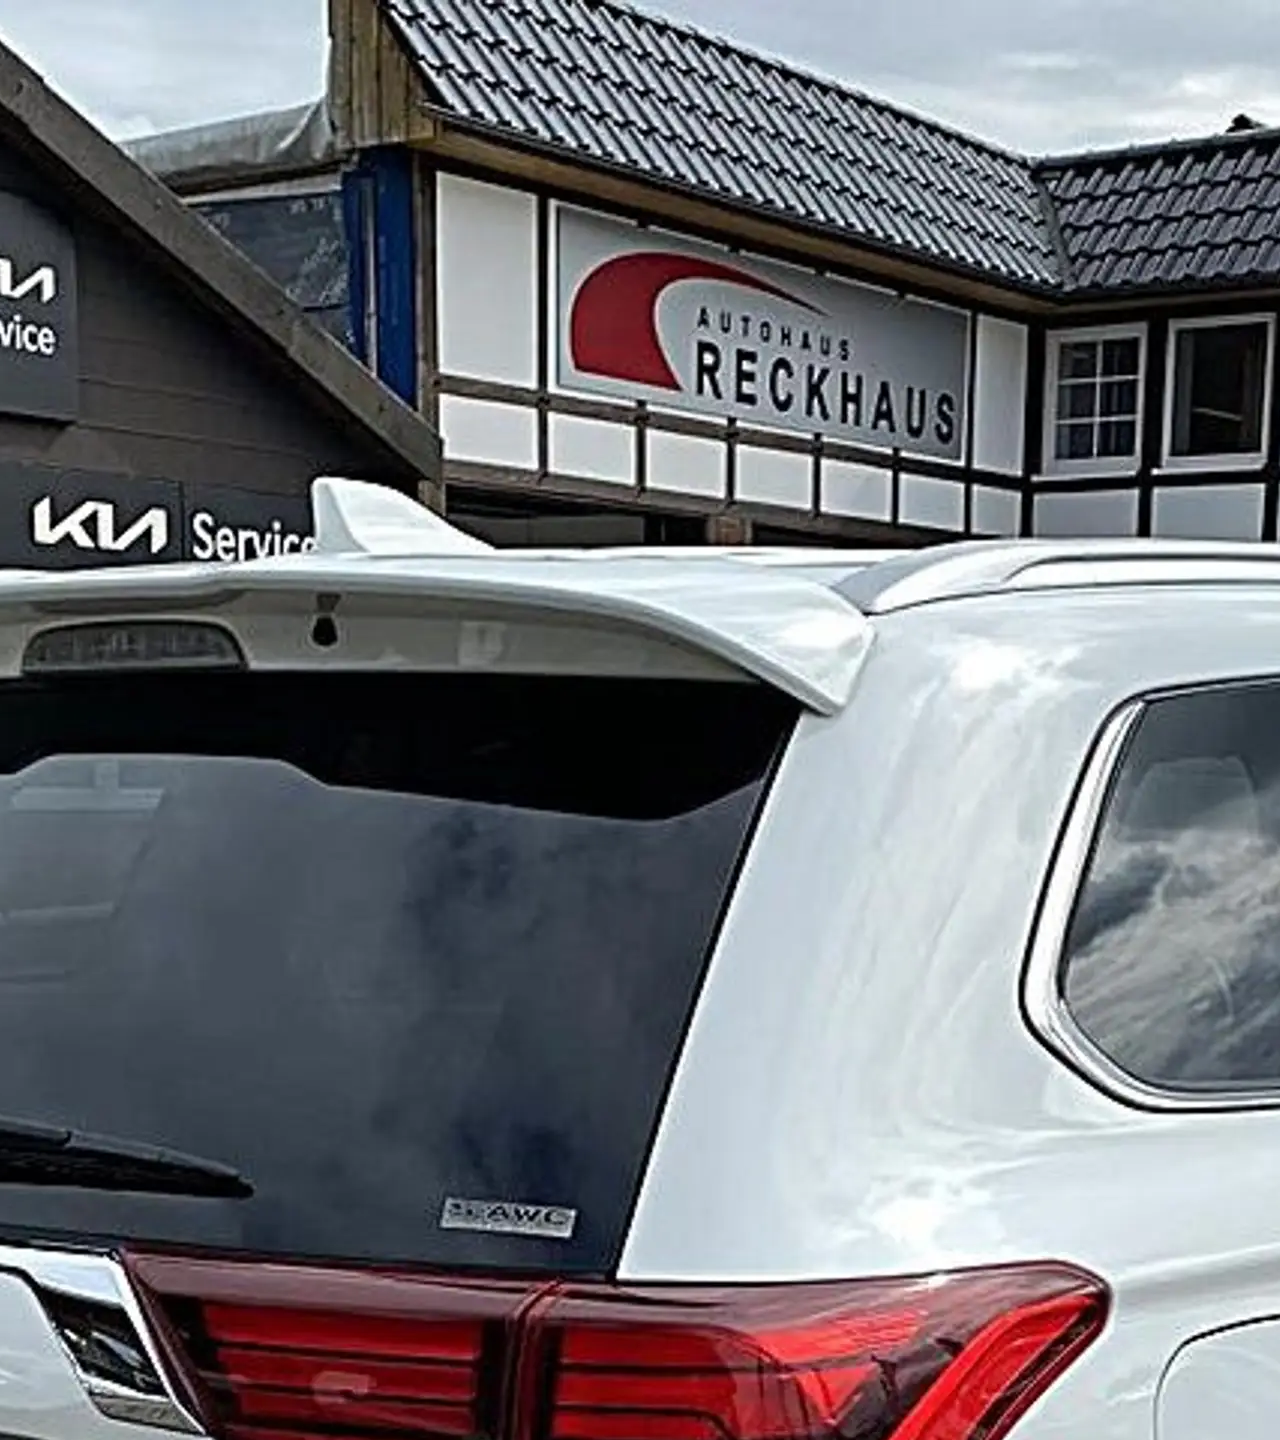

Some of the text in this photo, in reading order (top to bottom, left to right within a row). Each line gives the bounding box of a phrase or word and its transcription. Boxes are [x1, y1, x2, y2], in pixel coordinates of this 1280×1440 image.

[696, 306, 852, 362] AUTOHAUS
[696, 340, 956, 445] RECKHAUS
[32, 496, 169, 554] KIA
